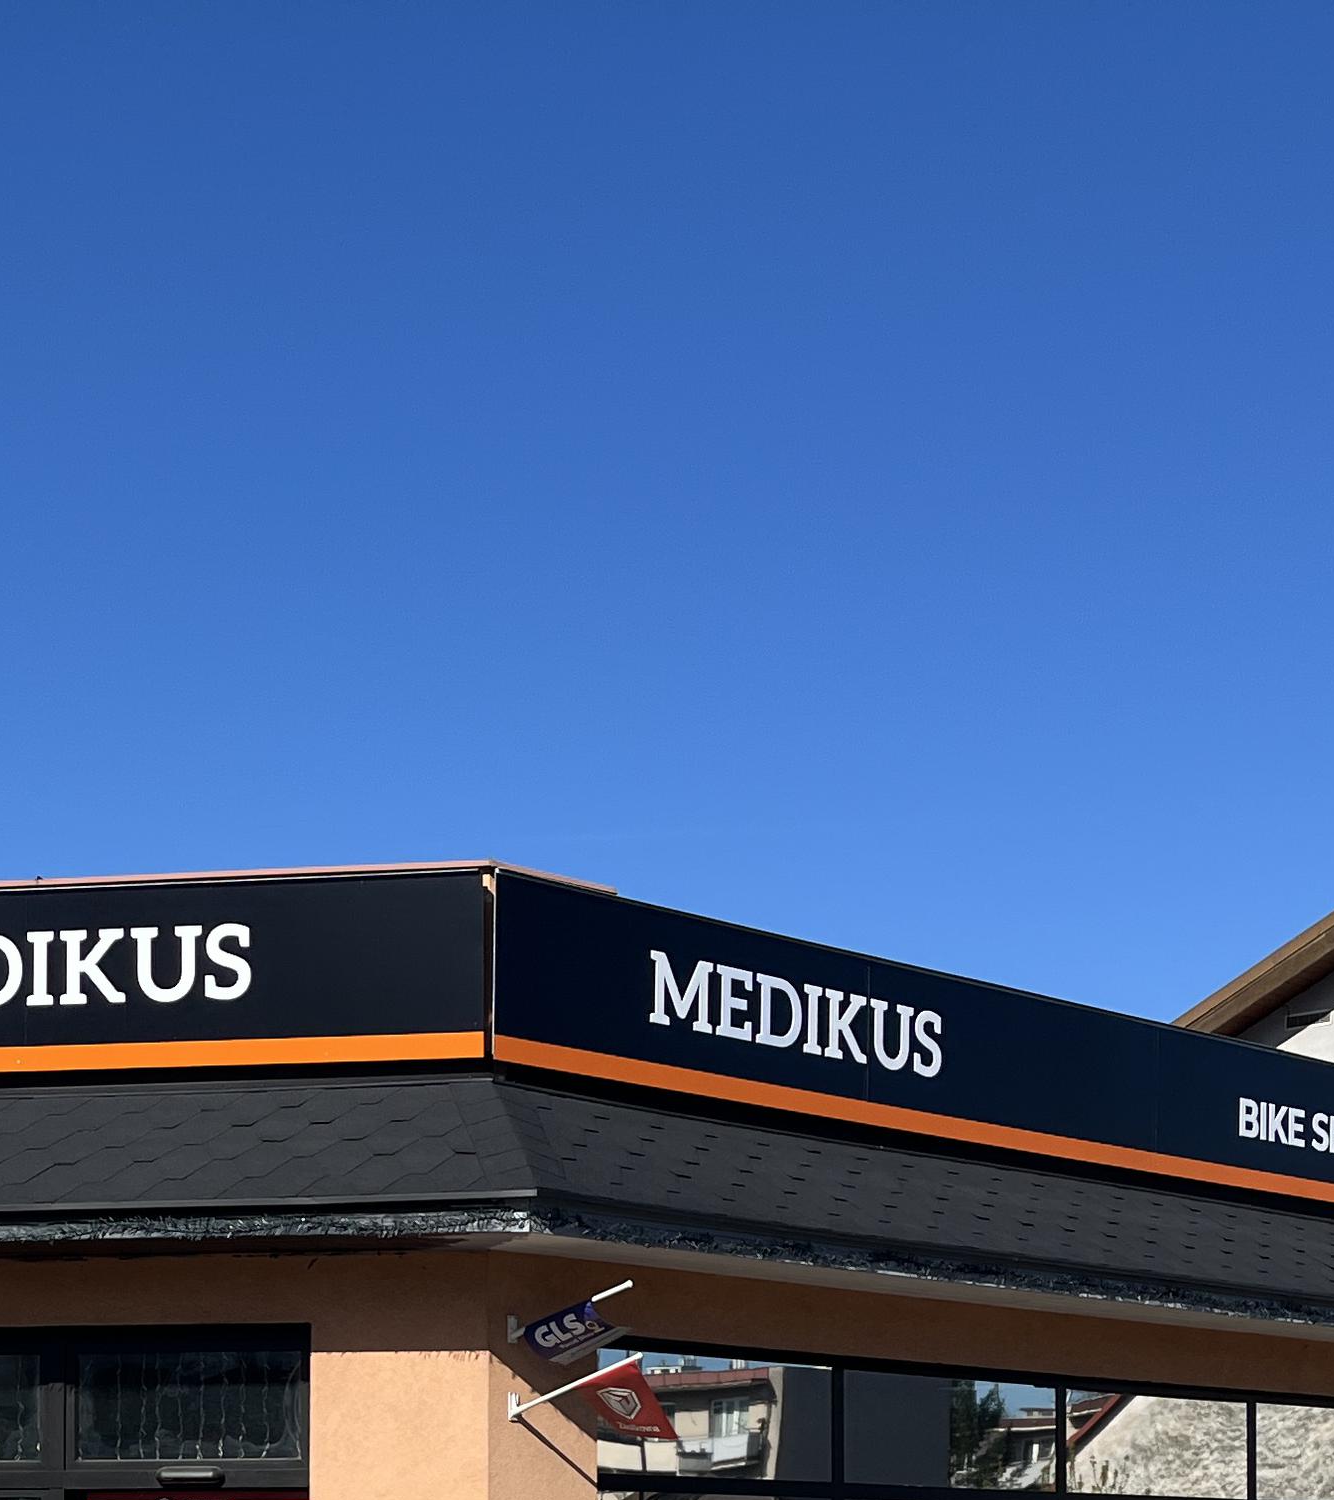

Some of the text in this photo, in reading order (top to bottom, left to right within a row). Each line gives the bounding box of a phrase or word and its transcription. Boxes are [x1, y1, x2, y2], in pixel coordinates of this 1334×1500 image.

[649, 949, 942, 1078] MEDIKUS
[1238, 1096, 1306, 1148] BIKE
[534, 1312, 586, 1348] GLS
